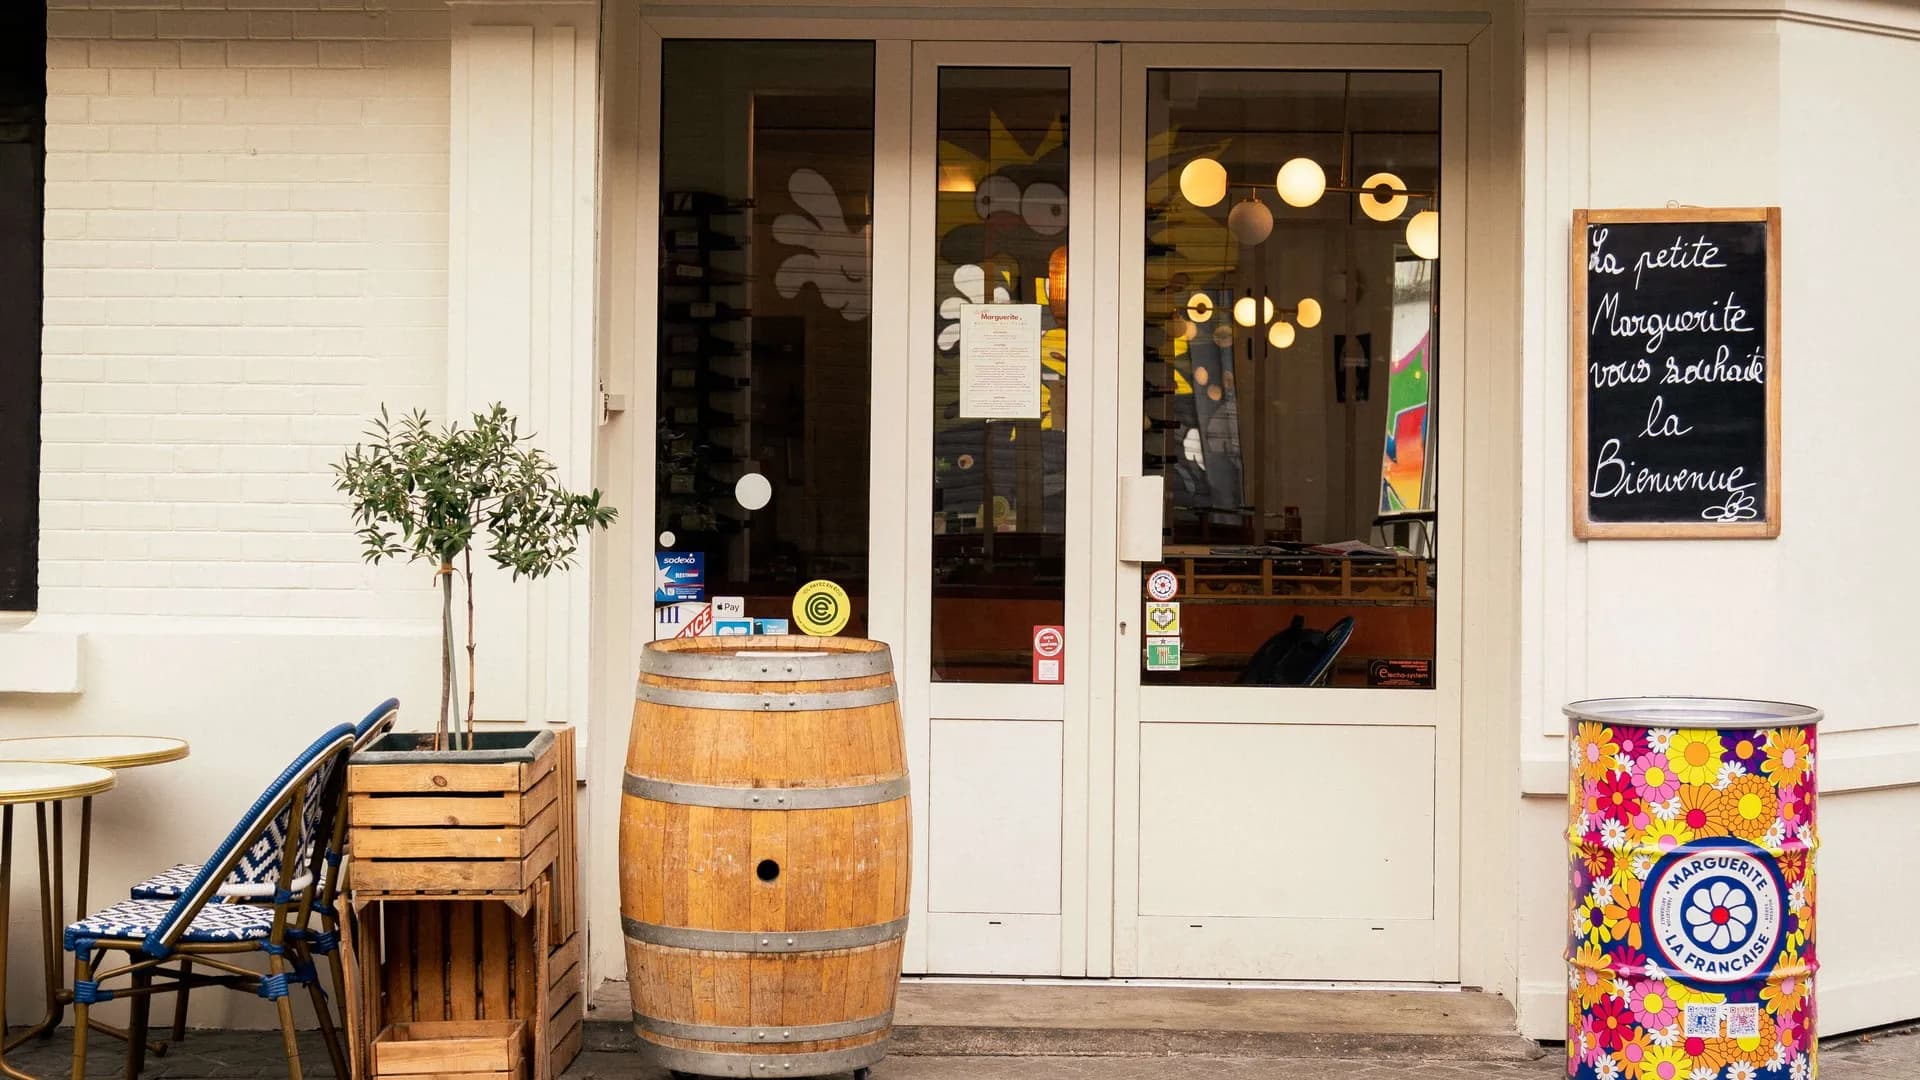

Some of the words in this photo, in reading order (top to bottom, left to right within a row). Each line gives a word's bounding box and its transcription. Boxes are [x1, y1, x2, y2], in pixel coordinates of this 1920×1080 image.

[1588, 227, 1625, 274] La
[1634, 235, 1727, 290] petite
[1592, 291, 1754, 353] Marguerite
[1590, 358, 1651, 388] vous
[1638, 395, 1694, 438] la
[1590, 438, 1757, 498] Bienvenue
[664, 553, 695, 564] sodexo
[724, 602, 740, 612] Pay
[1668, 857, 1768, 892] MARGUERITE
[1665, 933, 1686, 957] LA
